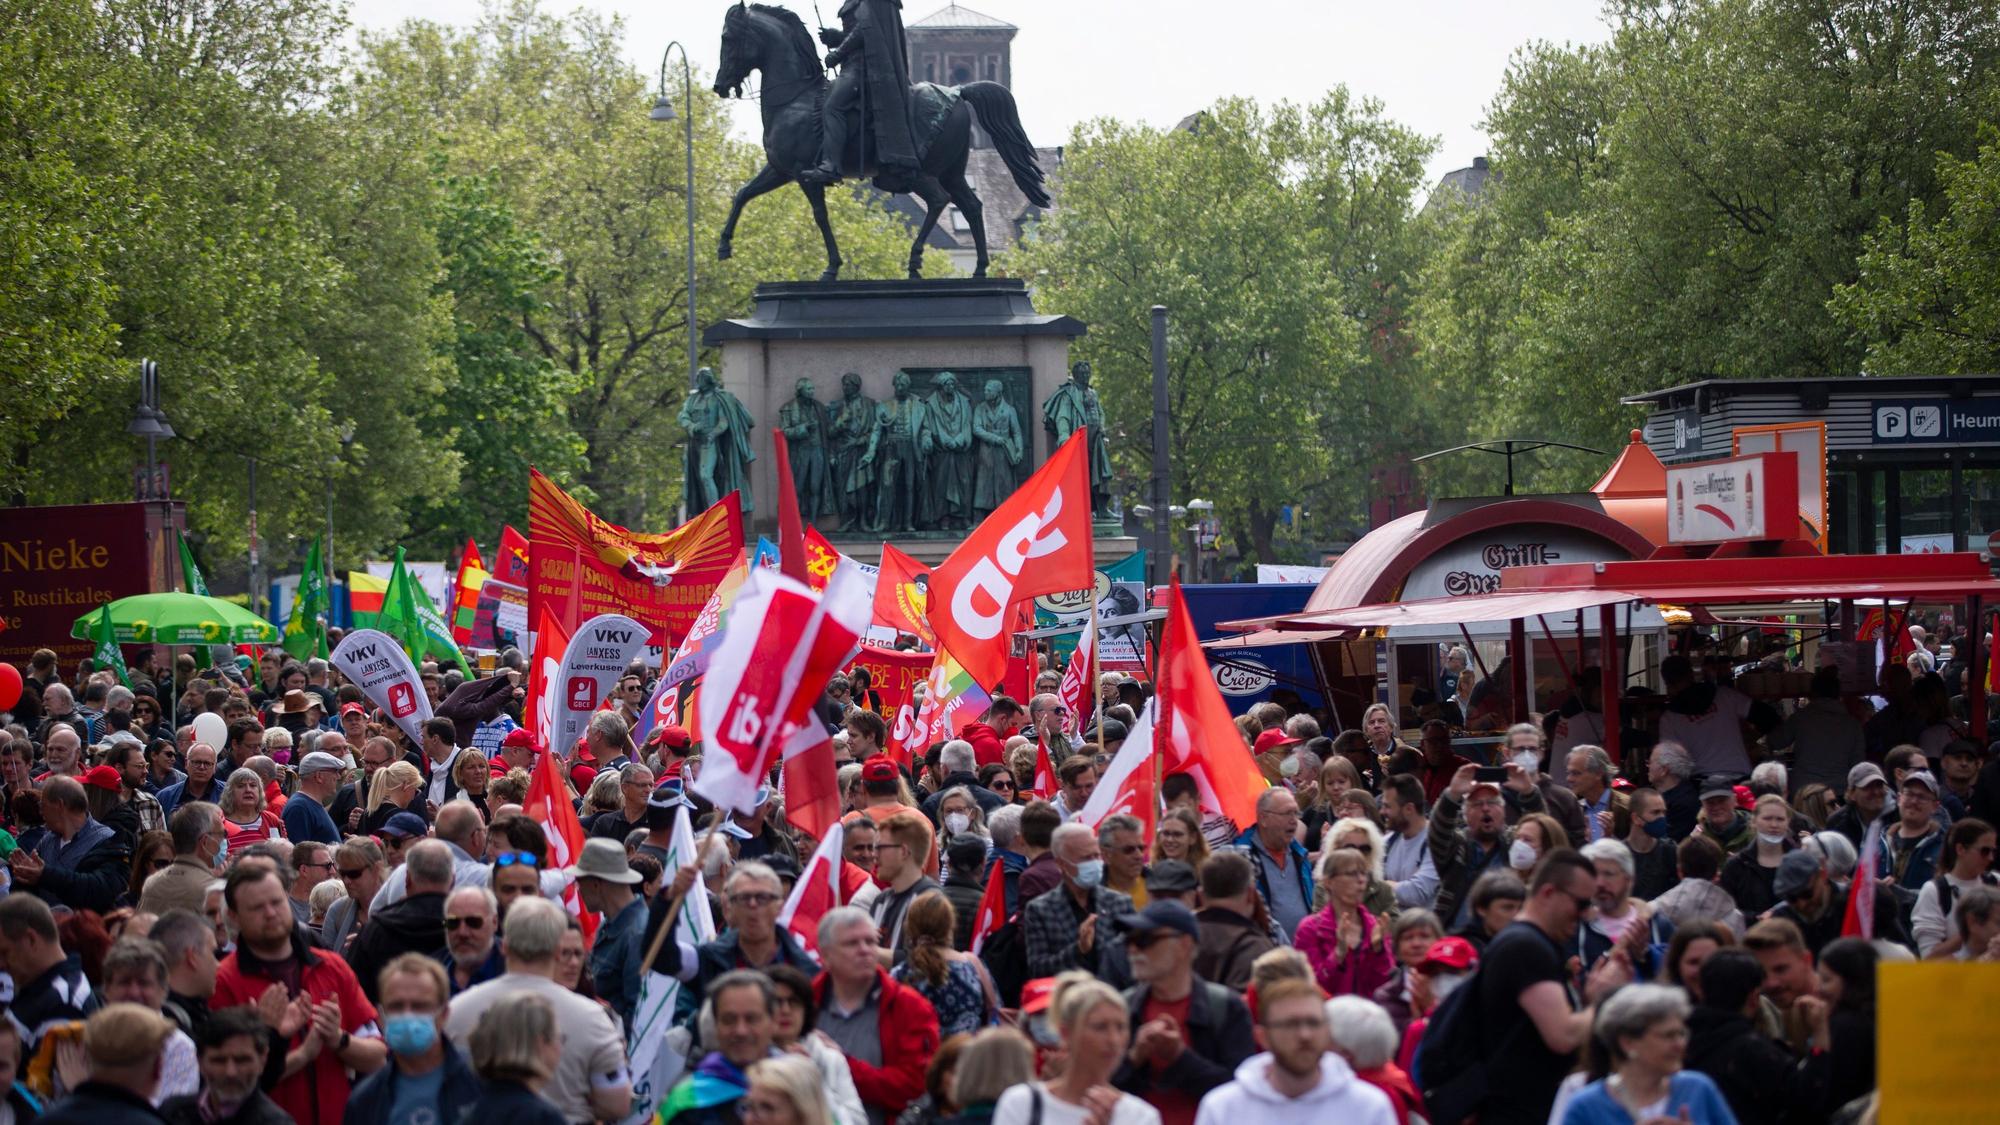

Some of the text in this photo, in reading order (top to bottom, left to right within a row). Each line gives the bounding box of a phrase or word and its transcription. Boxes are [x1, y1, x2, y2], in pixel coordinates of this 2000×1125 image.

[1, 539, 110, 572] Nieke
[1482, 543, 1560, 570] Grill-
[540, 557, 615, 592] SOZIAISMUS
[12, 587, 113, 607] Rustikales
[595, 629, 633, 644] VKV
[345, 643, 377, 664] VKV
[586, 647, 621, 660] LANXESS
[360, 657, 390, 675] LANXESS
[571, 662, 623, 672] Leverkusen
[362, 668, 407, 689] Leverkusen
[1217, 665, 1262, 690] Crêpe
